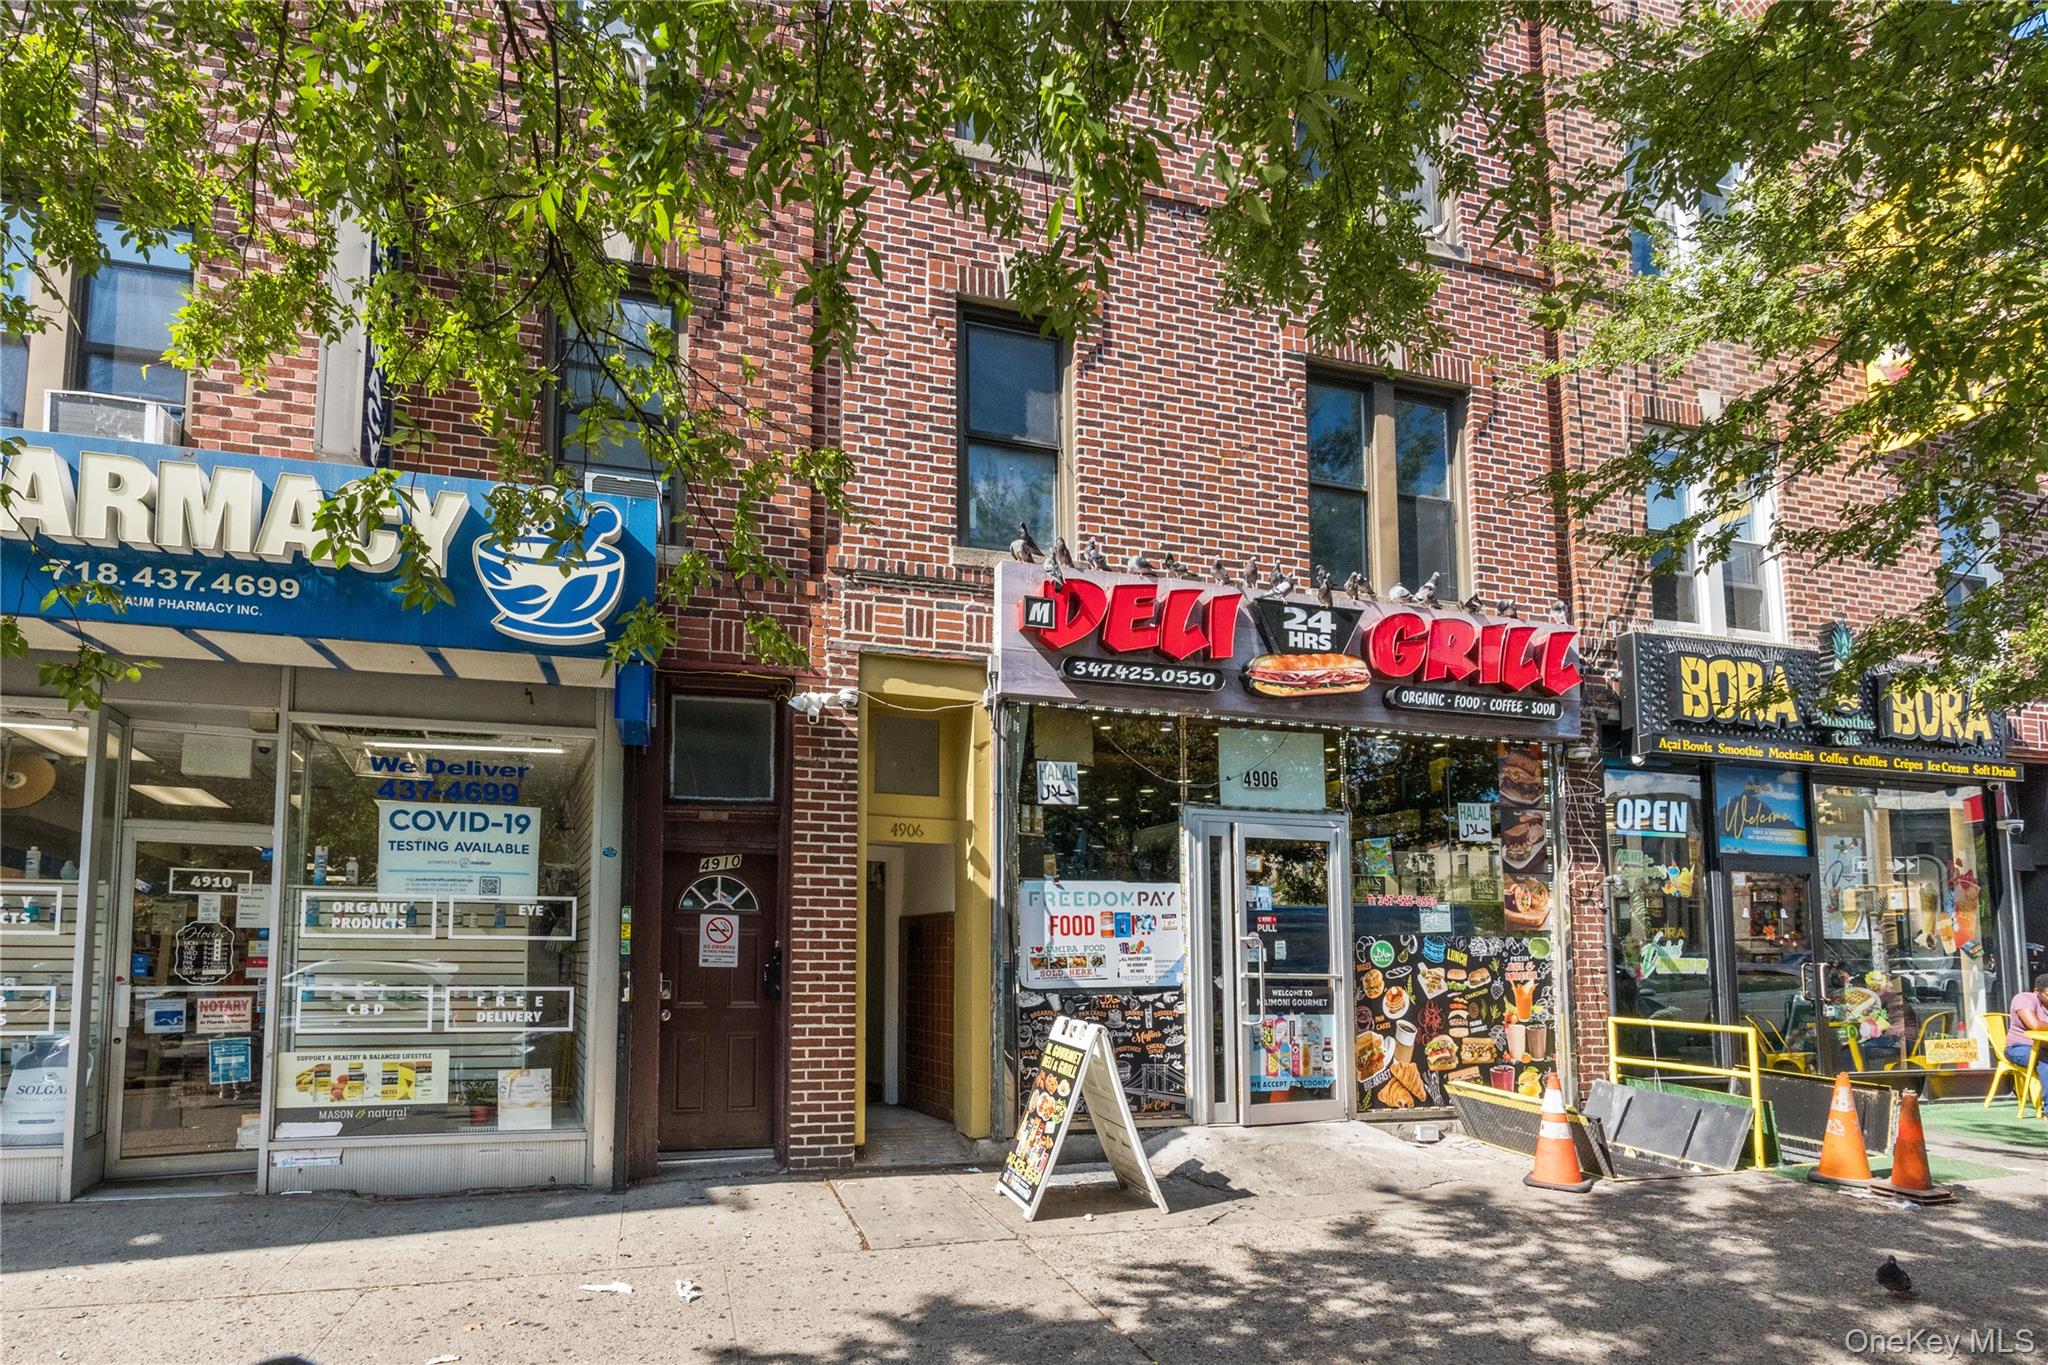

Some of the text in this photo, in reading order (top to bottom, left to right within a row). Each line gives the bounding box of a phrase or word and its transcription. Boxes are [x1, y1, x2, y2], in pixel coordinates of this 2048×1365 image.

[49, 559, 301, 600] 718.437.4699
[157, 599, 233, 615] PHARMACY
[236, 605, 263, 617] INC.
[1043, 577, 1245, 662] DELI
[1282, 606, 1337, 632] 24
[1288, 632, 1332, 652] HRS
[1366, 611, 1584, 697] GRILL
[1072, 659, 1217, 691] 347.425.0550
[1679, 656, 1800, 725] BORA
[1399, 689, 1557, 717] ORGANIC FOOD COFFEE SODA
[1890, 681, 1992, 741] BORA
[1820, 713, 1876, 731] Smoothie
[370, 755, 530, 779] We Deliver
[1682, 739, 1713, 753] Bowls
[1717, 743, 1764, 758] Smoothie
[1768, 747, 1815, 762] Mocktails
[1819, 751, 1849, 765] Coffee
[1852, 754, 1888, 768] Croffles
[1927, 760, 1941, 772] Ice
[1941, 762, 1969, 774] Cream
[1972, 763, 1990, 775] Soft
[1990, 765, 2017, 777] Drink
[1038, 764, 1077, 782] HALAL
[1243, 770, 1279, 789] 4906
[377, 778, 520, 807] 437-4699
[1459, 803, 1490, 822] HALAL
[1616, 797, 1688, 833] OPEN
[388, 809, 533, 835] COVID-19
[890, 822, 924, 838] 4906
[388, 840, 530, 855] TESTING AVAILABLE
[700, 855, 741, 871] 4910
[190, 875, 233, 888] 4910
[331, 901, 407, 915] ORGANIC
[518, 904, 544, 917] EYE
[331, 917, 407, 930] PRODUCTS
[1049, 914, 1096, 938] FOOD
[1256, 924, 1278, 933] PULL
[182, 926, 228, 940] Hours
[1446, 947, 1469, 967] LUNCH
[1040, 969, 1064, 978] SOLD
[1271, 989, 1313, 997] WELCOME TO
[199, 1000, 248, 1012] NOTARY
[1291, 998, 1328, 1007] GOURMET
[476, 1011, 543, 1023] DELIVERY
[1250, 1081, 1261, 1089] WE
[1363, 1068, 1393, 1092] BREAKFAST
[318, 1109, 354, 1120] MASON
[367, 1107, 407, 1119] natural
